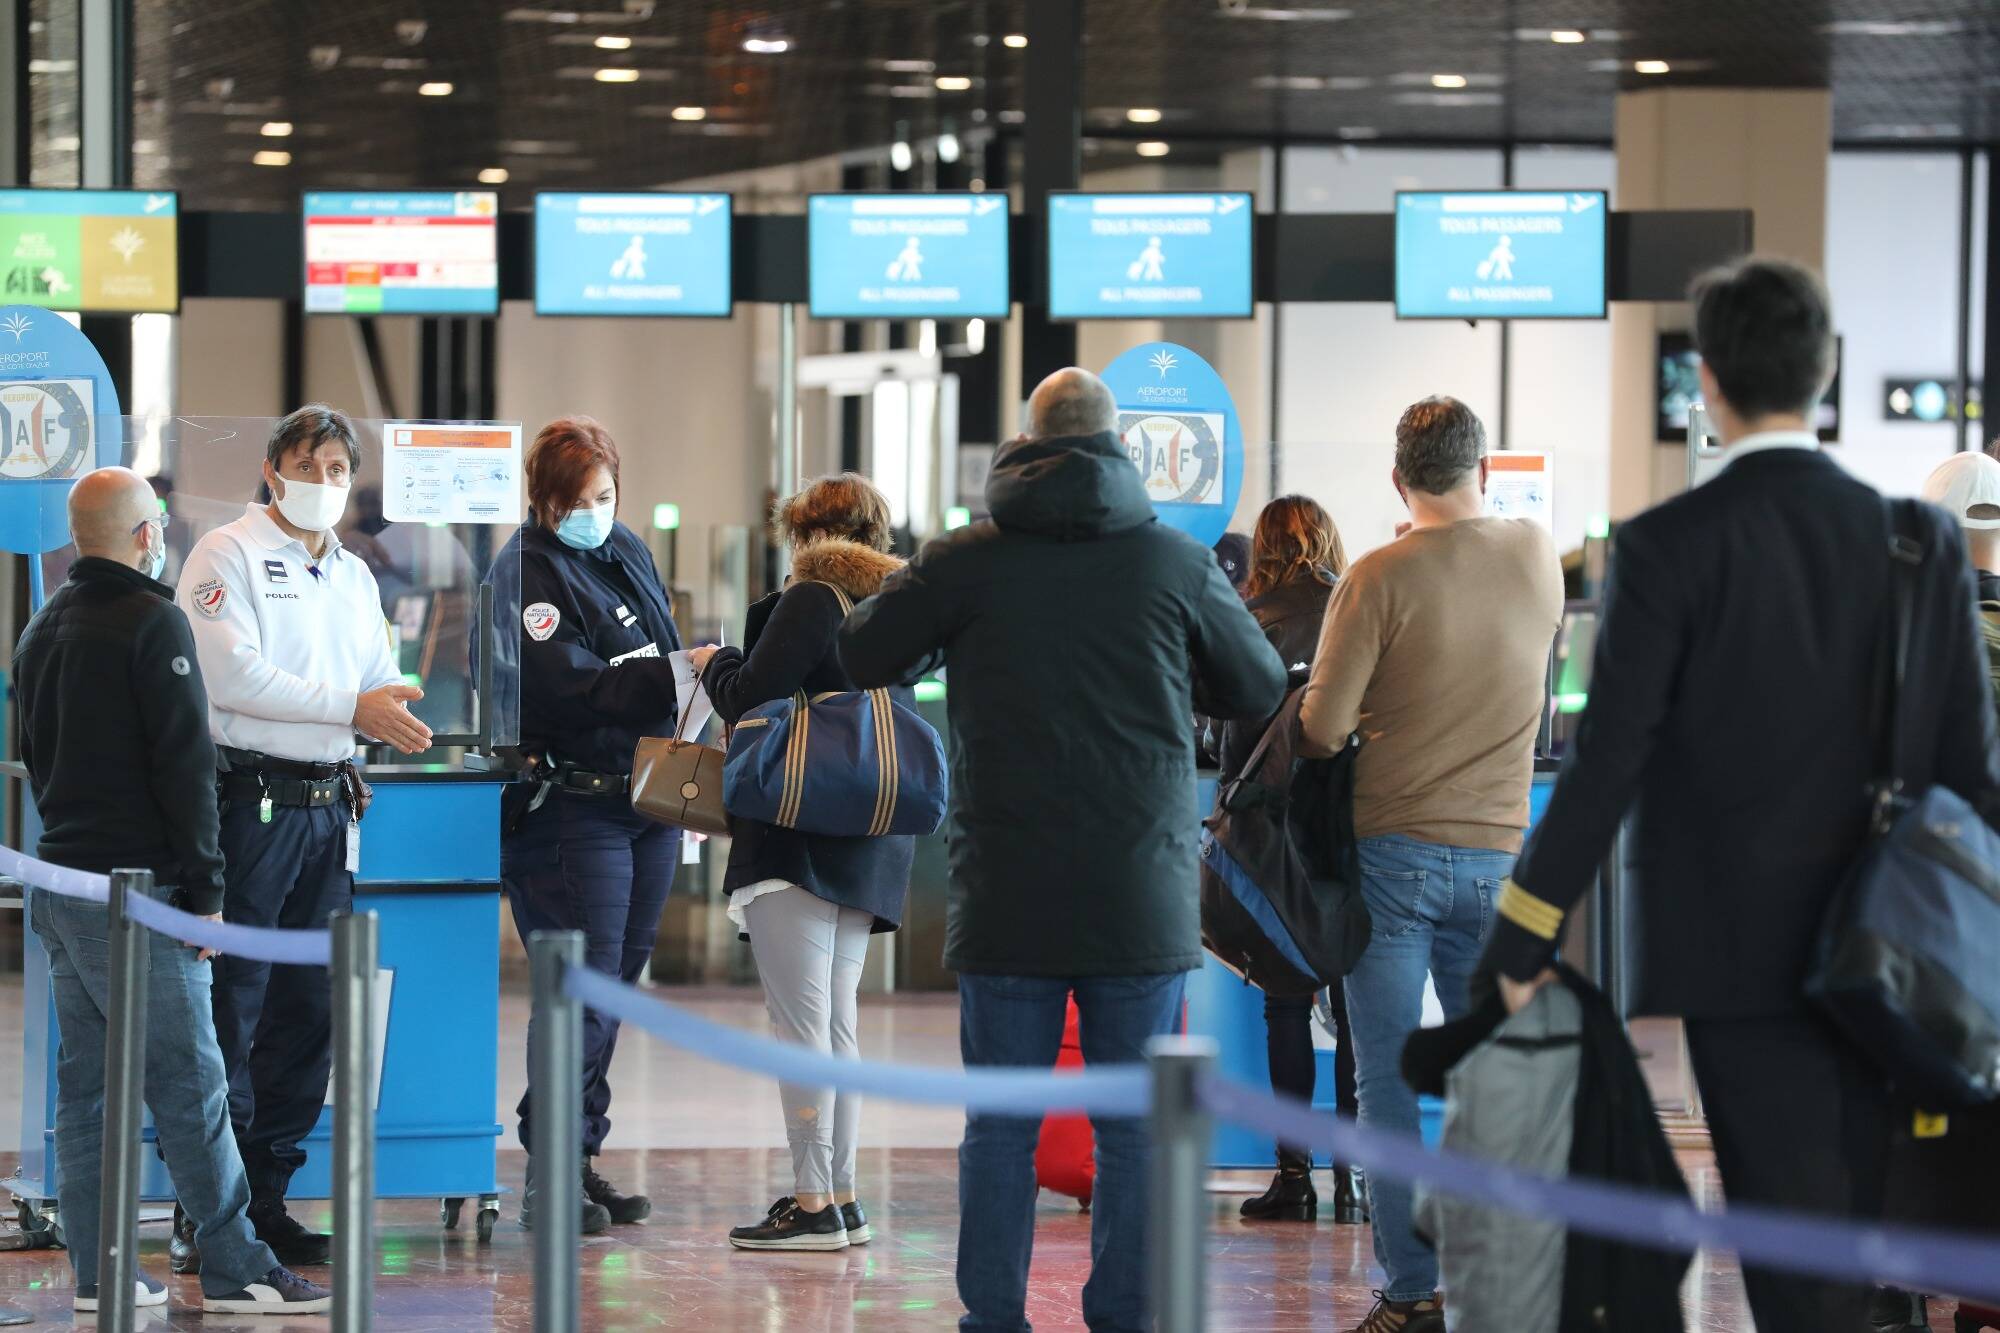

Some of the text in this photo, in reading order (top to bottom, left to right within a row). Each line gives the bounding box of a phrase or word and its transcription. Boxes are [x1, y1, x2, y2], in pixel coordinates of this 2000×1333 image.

[1091, 219, 1129, 235] TOUS
[1440, 217, 1563, 233] TOUS PASSAGERS
[1448, 287, 1470, 301] ALL
[0, 352, 48, 363] EROPORT
[1137, 386, 1187, 397] AEROPORT
[194, 584, 223, 595] NATIONALE
[199, 580, 217, 588] POLICE
